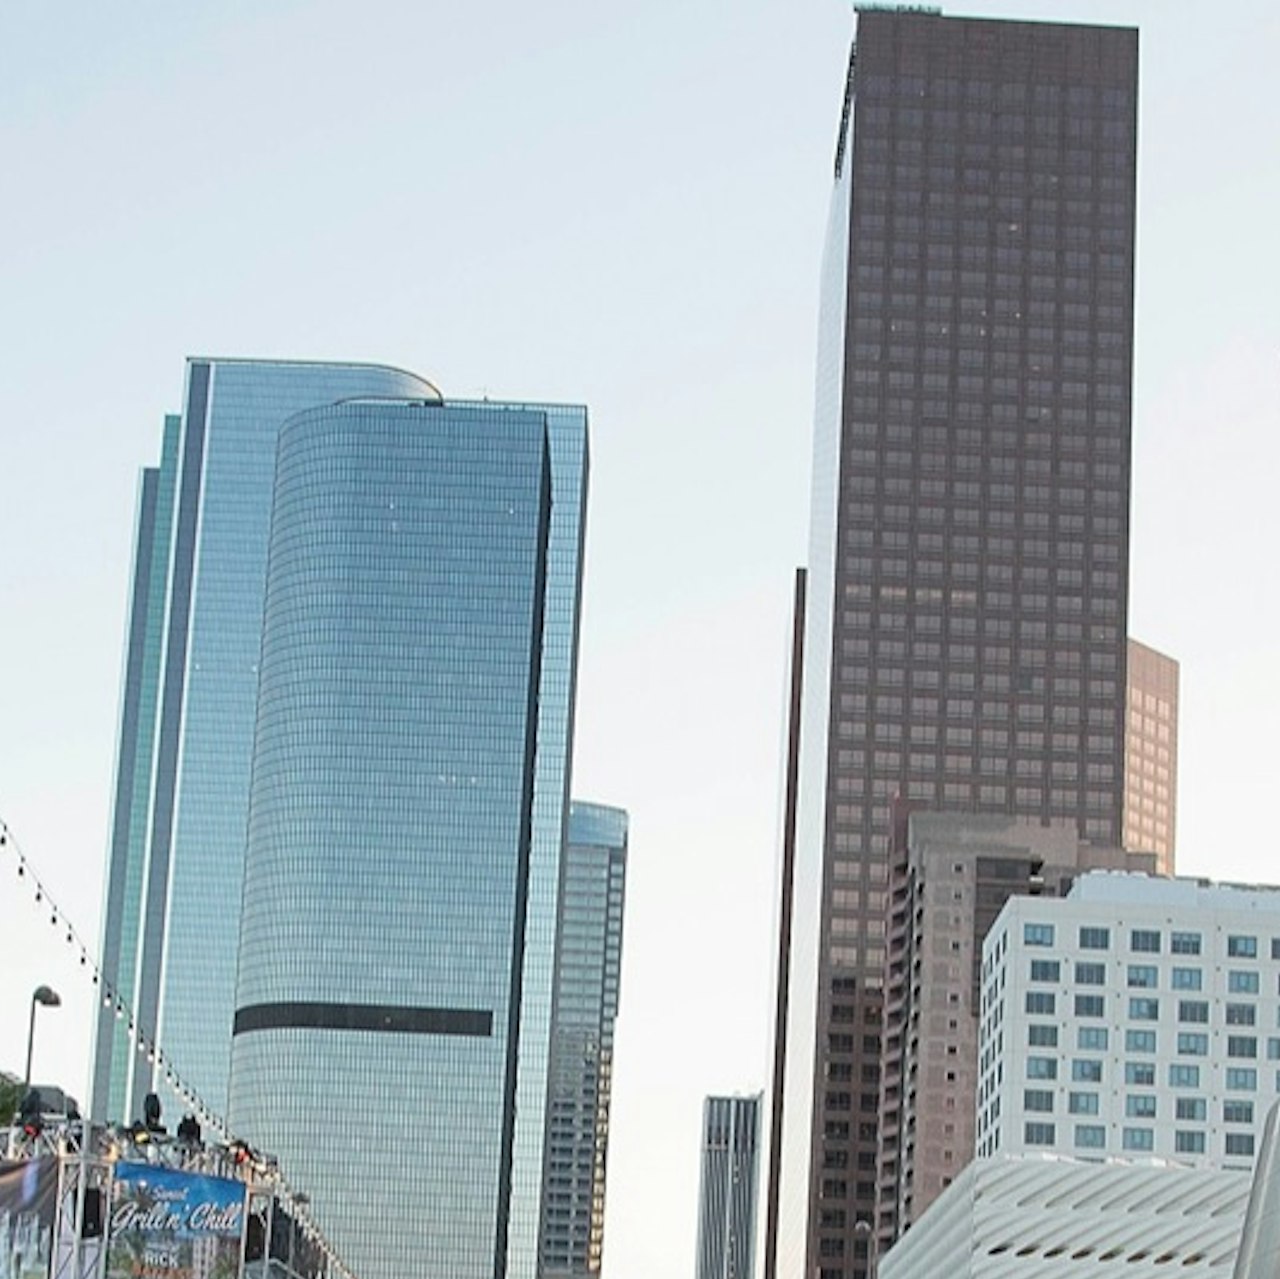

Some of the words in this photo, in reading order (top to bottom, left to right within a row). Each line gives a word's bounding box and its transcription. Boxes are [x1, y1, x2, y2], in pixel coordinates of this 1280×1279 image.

[111, 1201, 169, 1238] Grill
[191, 1202, 242, 1231] Chill
[145, 1251, 179, 1269] RICK
